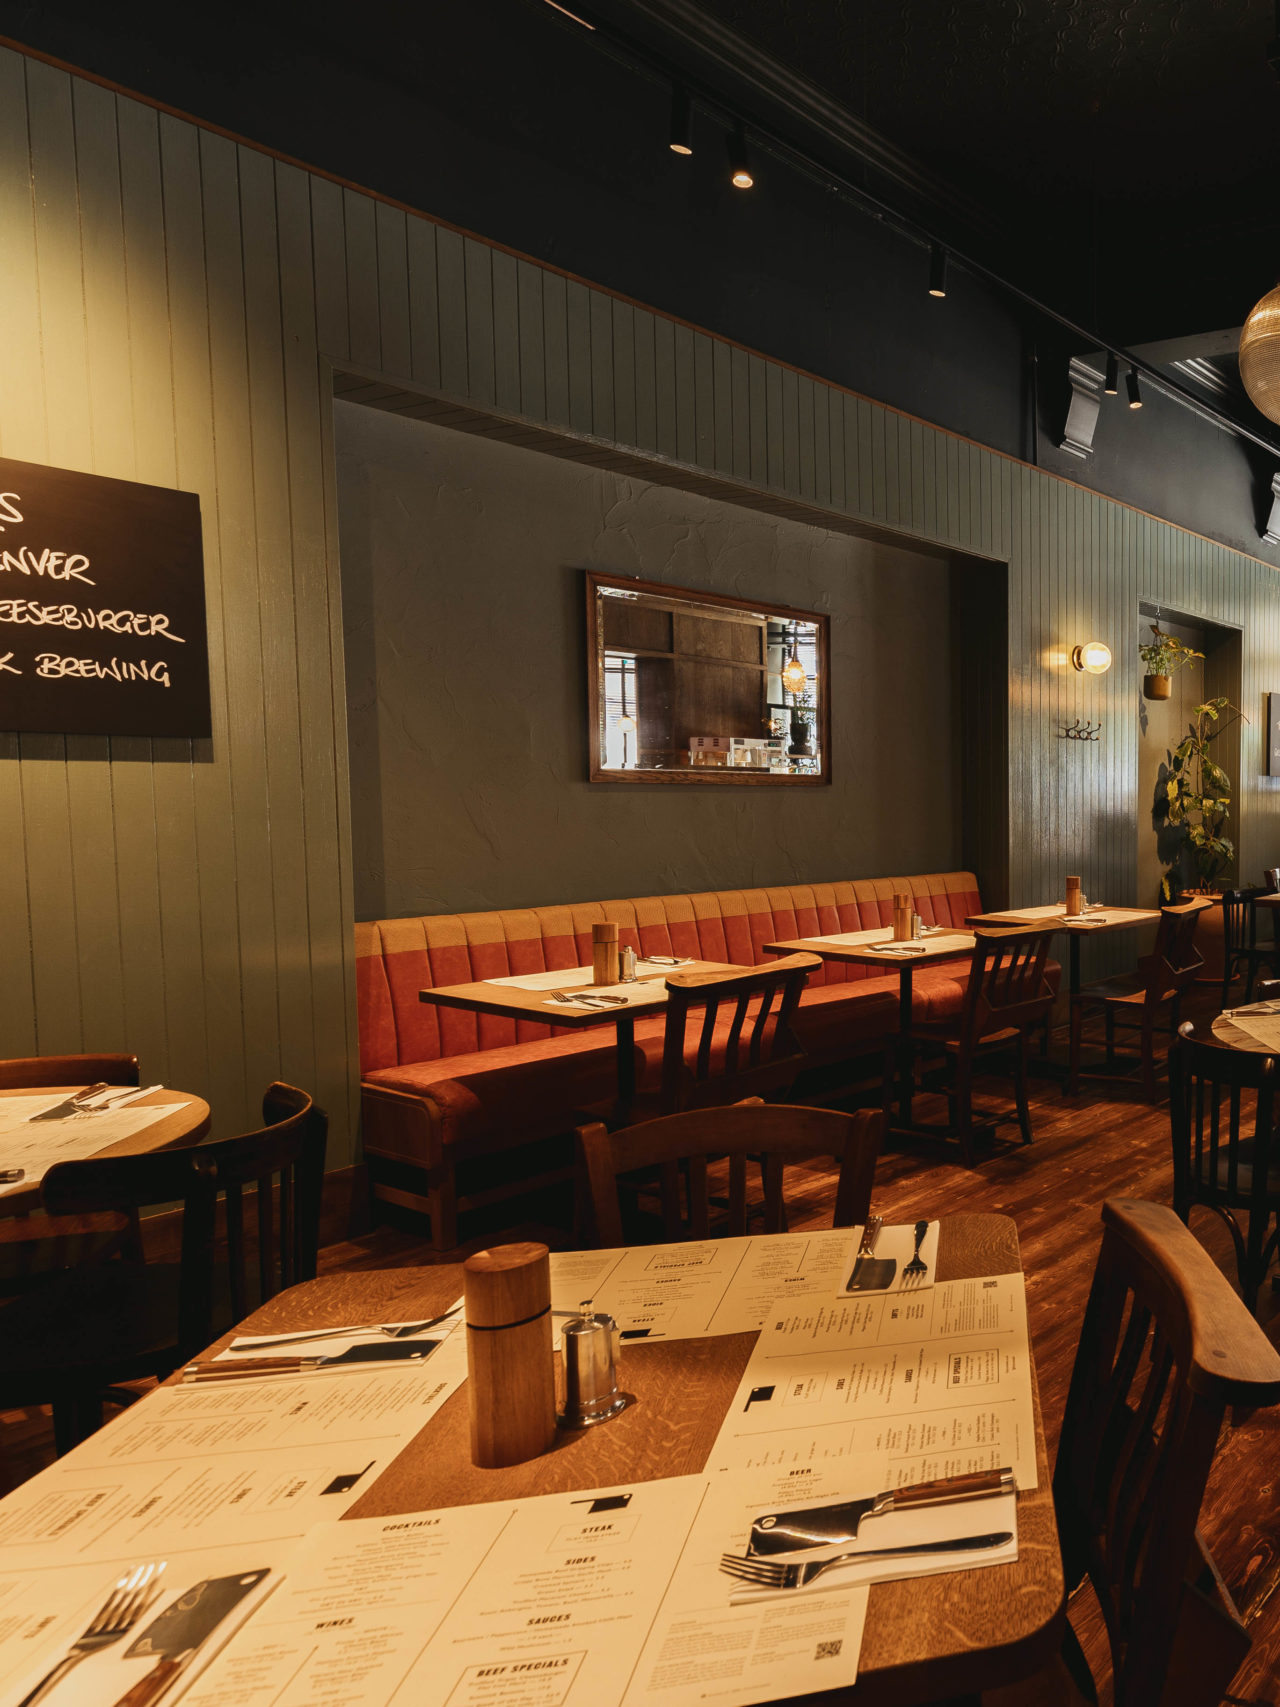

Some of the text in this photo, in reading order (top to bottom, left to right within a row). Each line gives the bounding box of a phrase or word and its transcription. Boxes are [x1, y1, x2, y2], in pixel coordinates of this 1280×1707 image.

[0, 546, 97, 586] NVER
[34, 653, 171, 688] BREWING
[789, 1468, 812, 1477] BEER
[382, 1518, 442, 1532] COCKTAILS
[581, 1523, 615, 1535] STEAK
[564, 1555, 597, 1566] SIDES
[315, 1616, 355, 1630] WINES
[526, 1613, 572, 1626] SAUCES
[476, 1658, 570, 1678] BEEF SPECIALS
